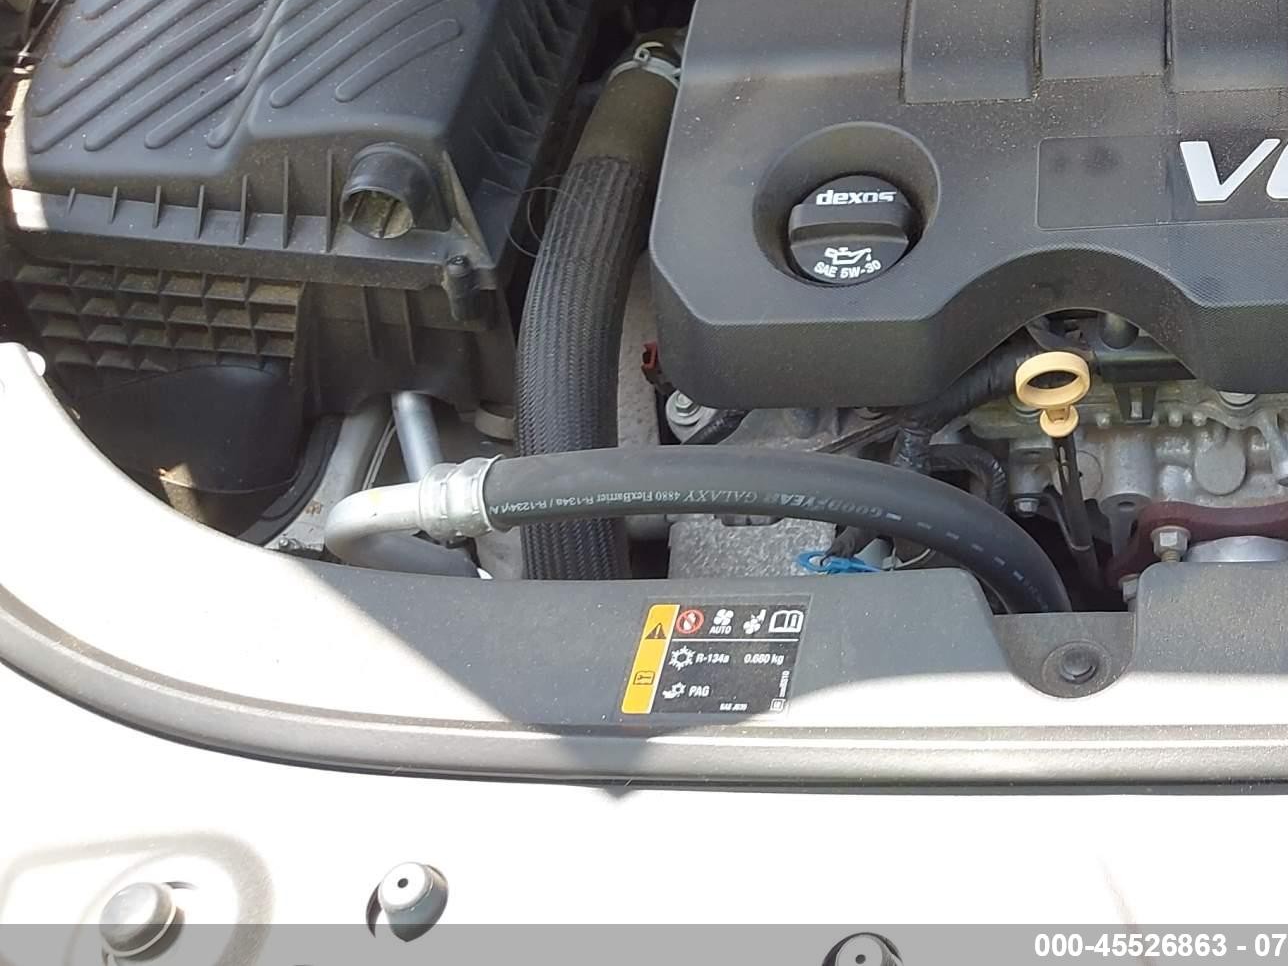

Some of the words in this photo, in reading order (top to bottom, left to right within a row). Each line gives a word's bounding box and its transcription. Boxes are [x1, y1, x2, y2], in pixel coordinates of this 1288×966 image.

[816, 189, 897, 205] dexos
[814, 261, 838, 278] SAE
[840, 259, 882, 279] 5W-30
[709, 626, 732, 634] AUTO
[771, 654, 785, 666] kg
[688, 685, 710, 697] PAG
